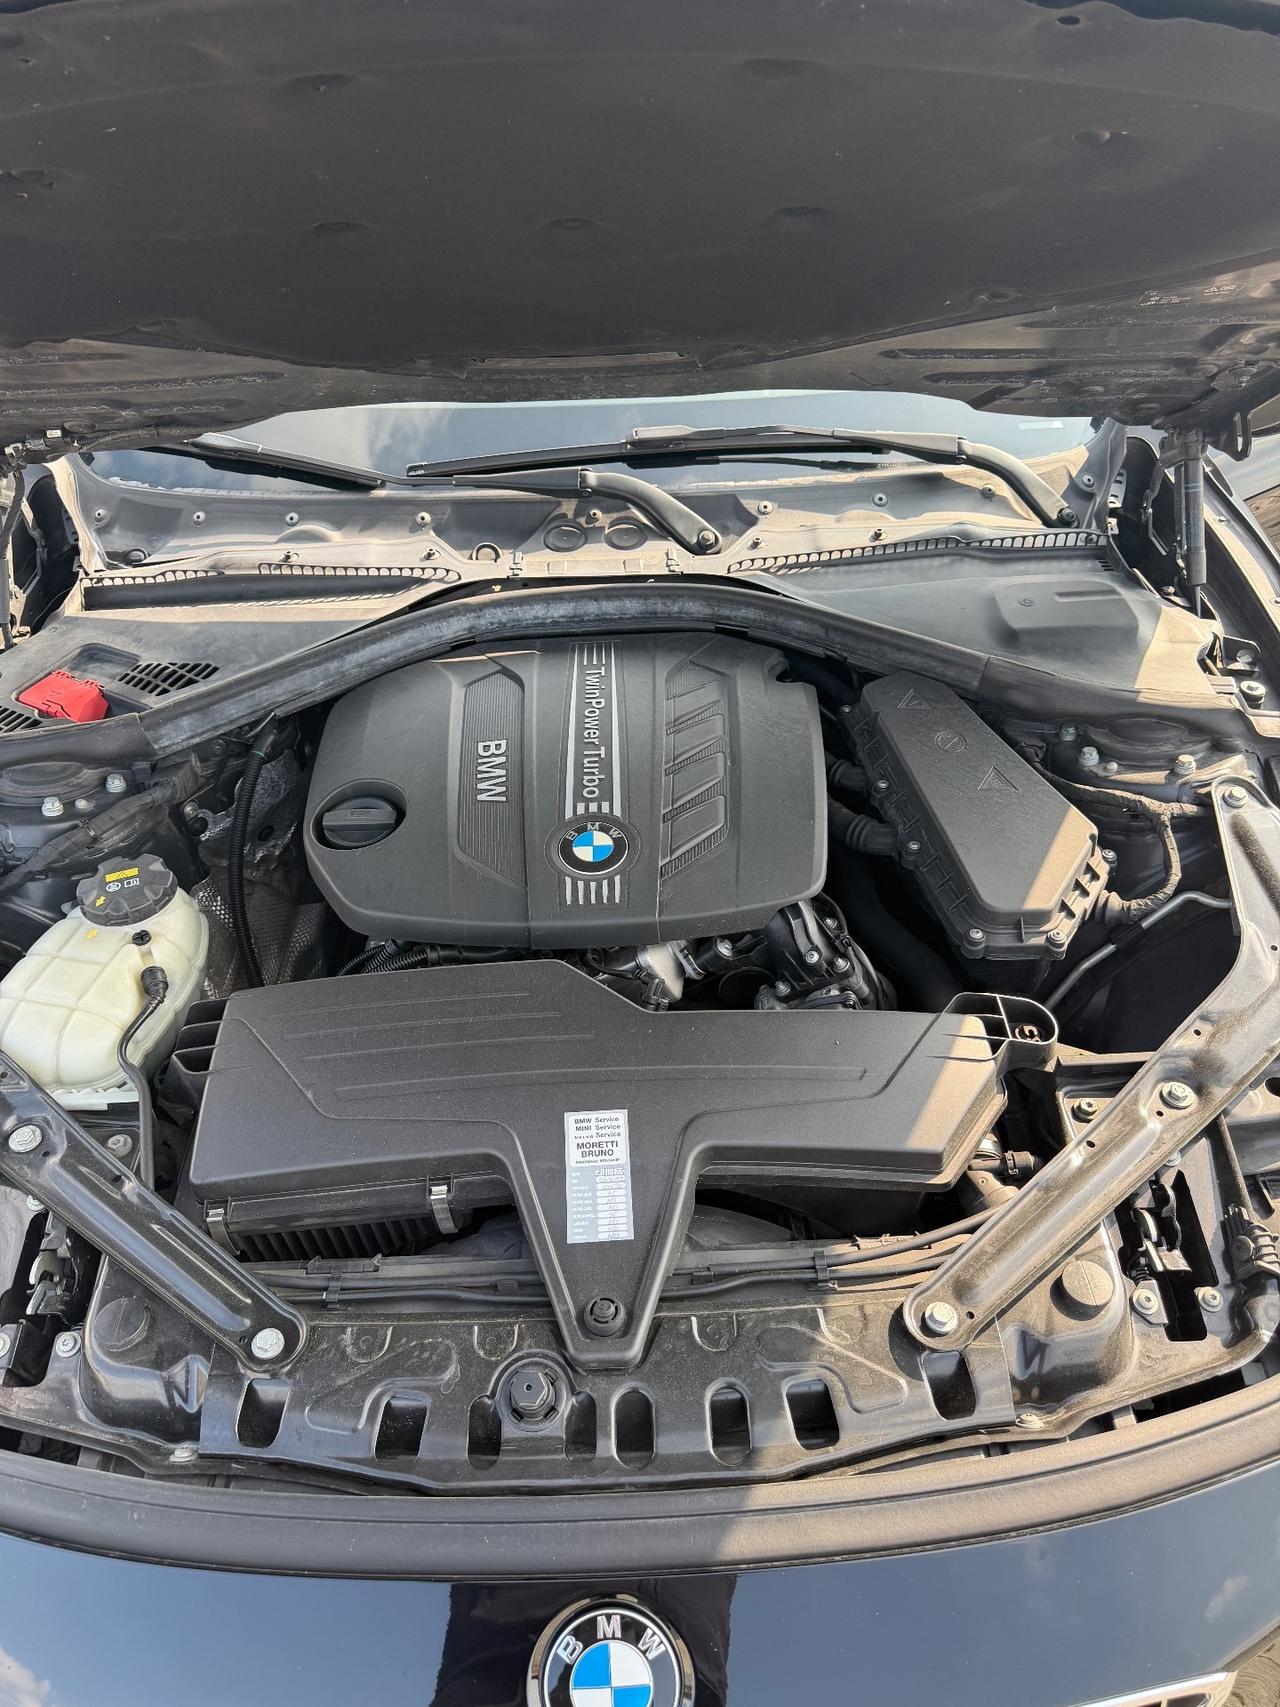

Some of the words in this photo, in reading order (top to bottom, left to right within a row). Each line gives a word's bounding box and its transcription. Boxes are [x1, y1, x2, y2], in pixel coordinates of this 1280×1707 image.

[583, 667, 606, 745] TwinPower
[476, 739, 507, 802] BMW
[582, 746, 605, 798] Turbo
[565, 822, 623, 841] BMW
[574, 1117, 592, 1125] BMW
[595, 1115, 620, 1123] Service
[595, 1123, 621, 1131] Service
[576, 1140, 619, 1150] MORETTI
[581, 1149, 614, 1158] BRUNO
[557, 1614, 666, 1665] BMW
